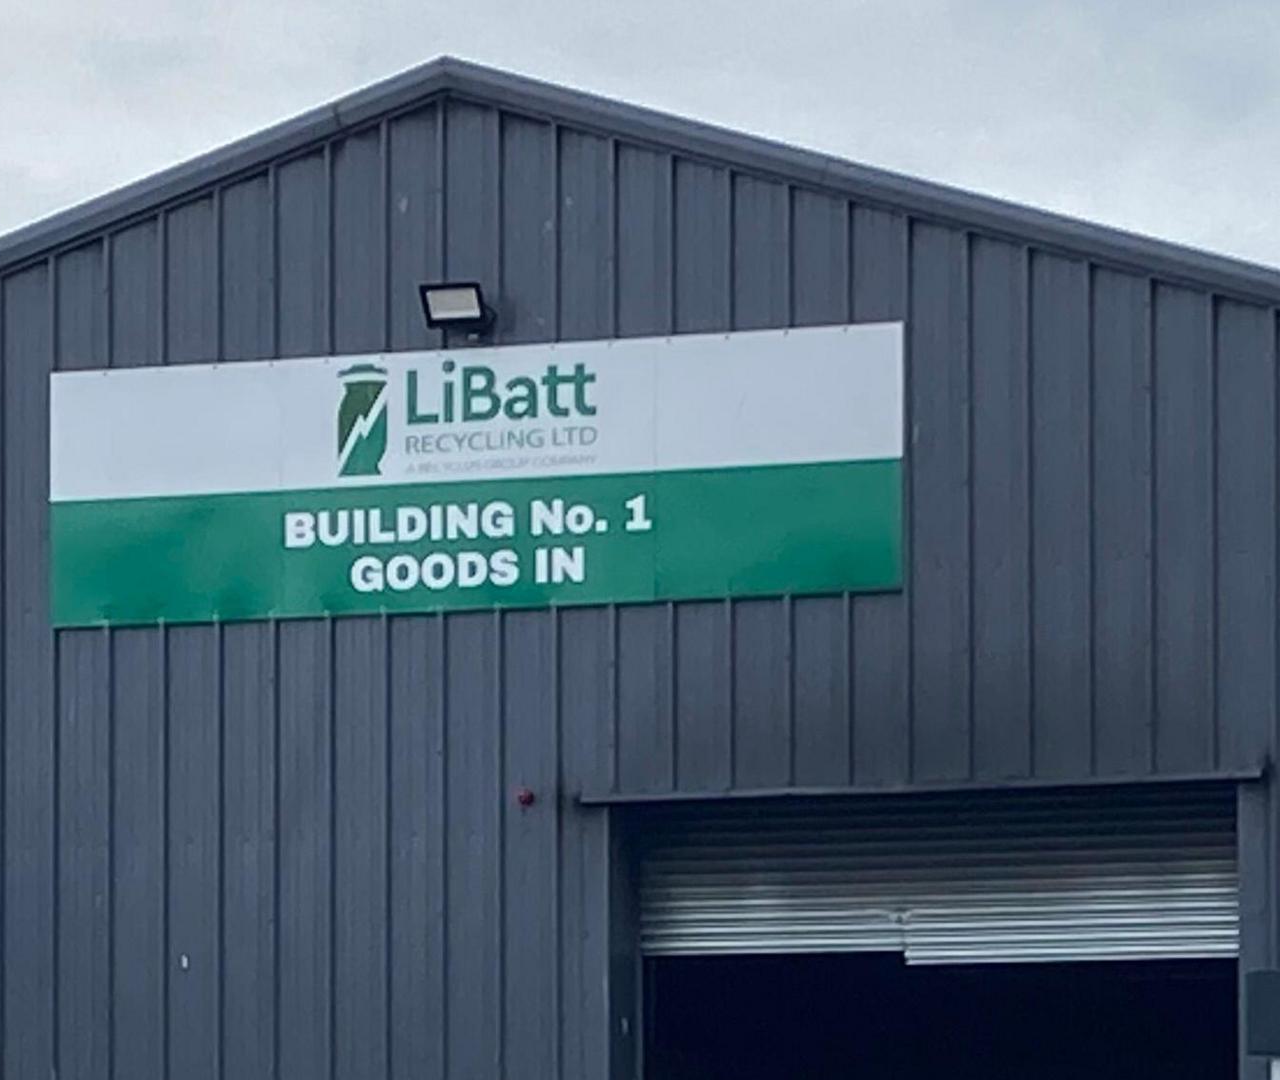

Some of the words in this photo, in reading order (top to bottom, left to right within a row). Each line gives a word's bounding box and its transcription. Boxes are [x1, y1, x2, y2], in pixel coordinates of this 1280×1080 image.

[406, 360, 597, 425] LiBatt
[405, 429, 544, 455] RECYCLING
[551, 426, 598, 447] LTD
[285, 501, 515, 548] BUILDING
[530, 498, 608, 536] No.
[625, 495, 652, 531] 1
[351, 549, 519, 592] GOODS
[535, 546, 585, 584] IN
